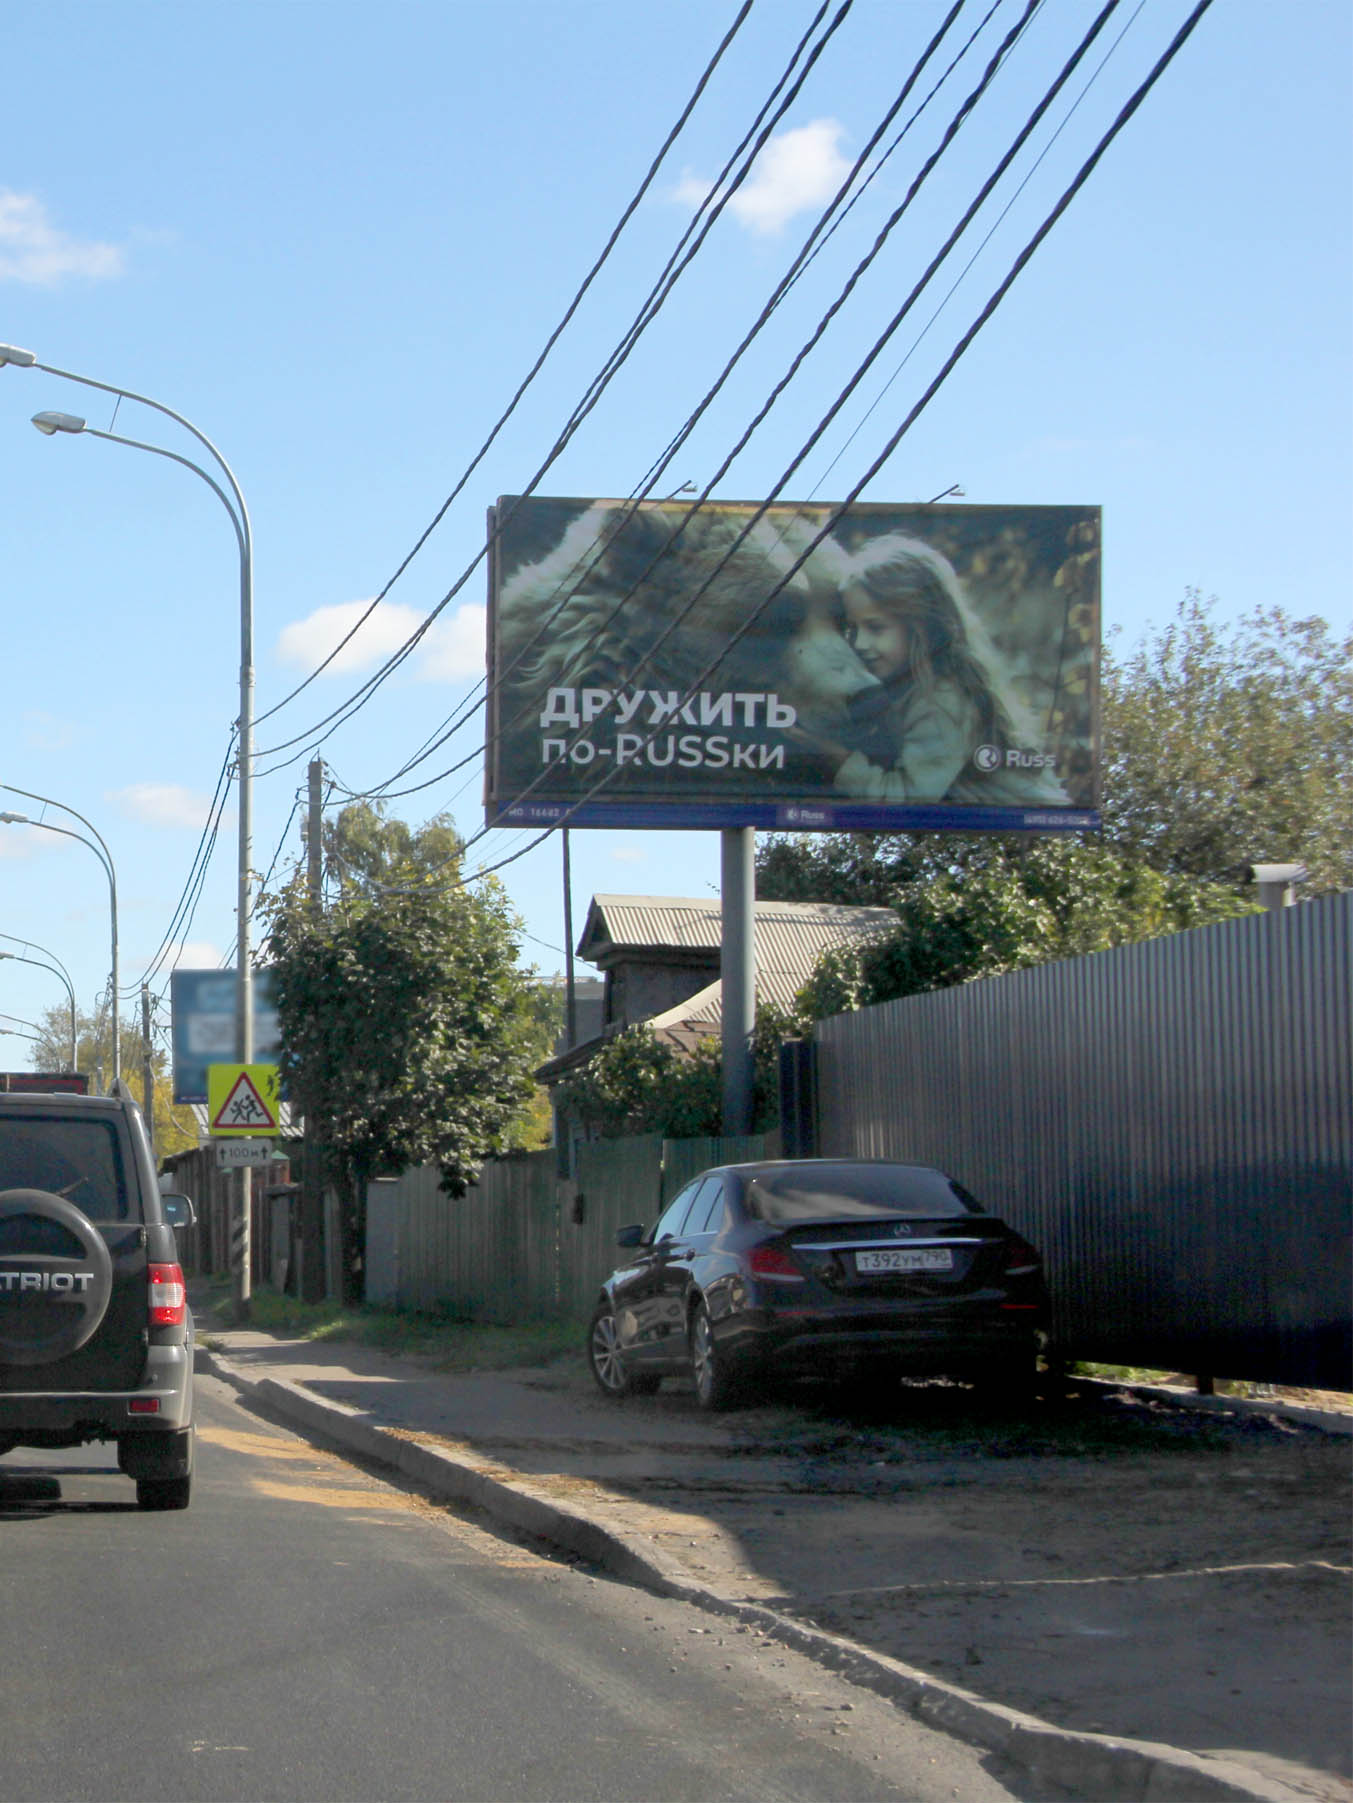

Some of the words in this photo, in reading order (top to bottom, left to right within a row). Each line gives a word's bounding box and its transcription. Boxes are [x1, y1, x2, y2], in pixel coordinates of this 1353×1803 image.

[540, 687, 797, 729] ДРУЖИТЬ
[542, 733, 785, 769] по-RUSSки
[1006, 749, 1057, 768] Russ
[229, 1146, 249, 1159] 100
